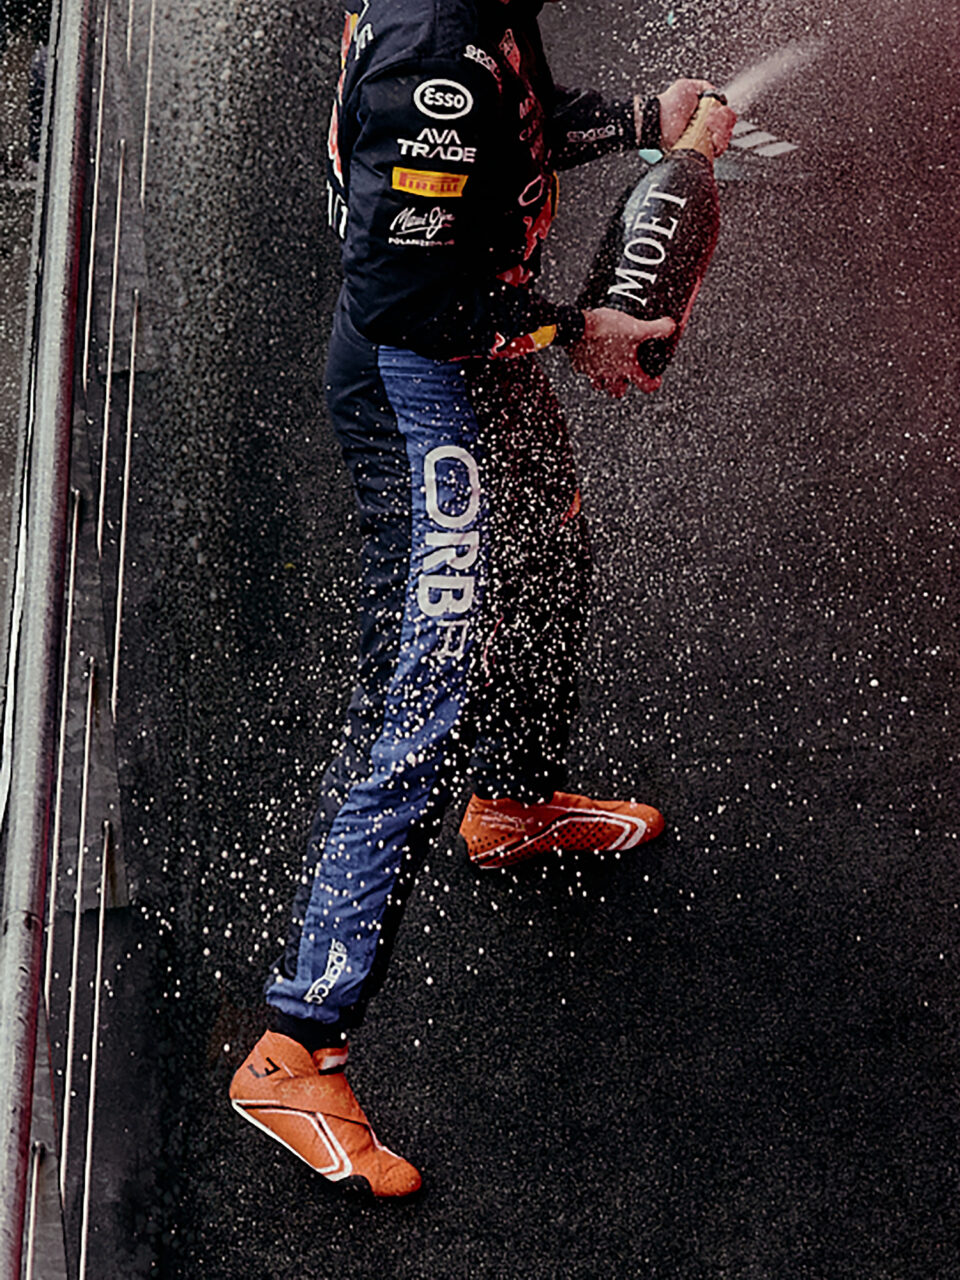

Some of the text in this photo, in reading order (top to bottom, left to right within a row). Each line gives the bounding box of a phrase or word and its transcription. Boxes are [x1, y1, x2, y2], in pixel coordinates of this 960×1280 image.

[423, 86, 465, 109] Esso
[416, 128, 462, 145] AVA
[397, 138, 477, 163] TRADE
[399, 171, 461, 193] PIRELLI
[304, 937, 347, 1004] sparco
